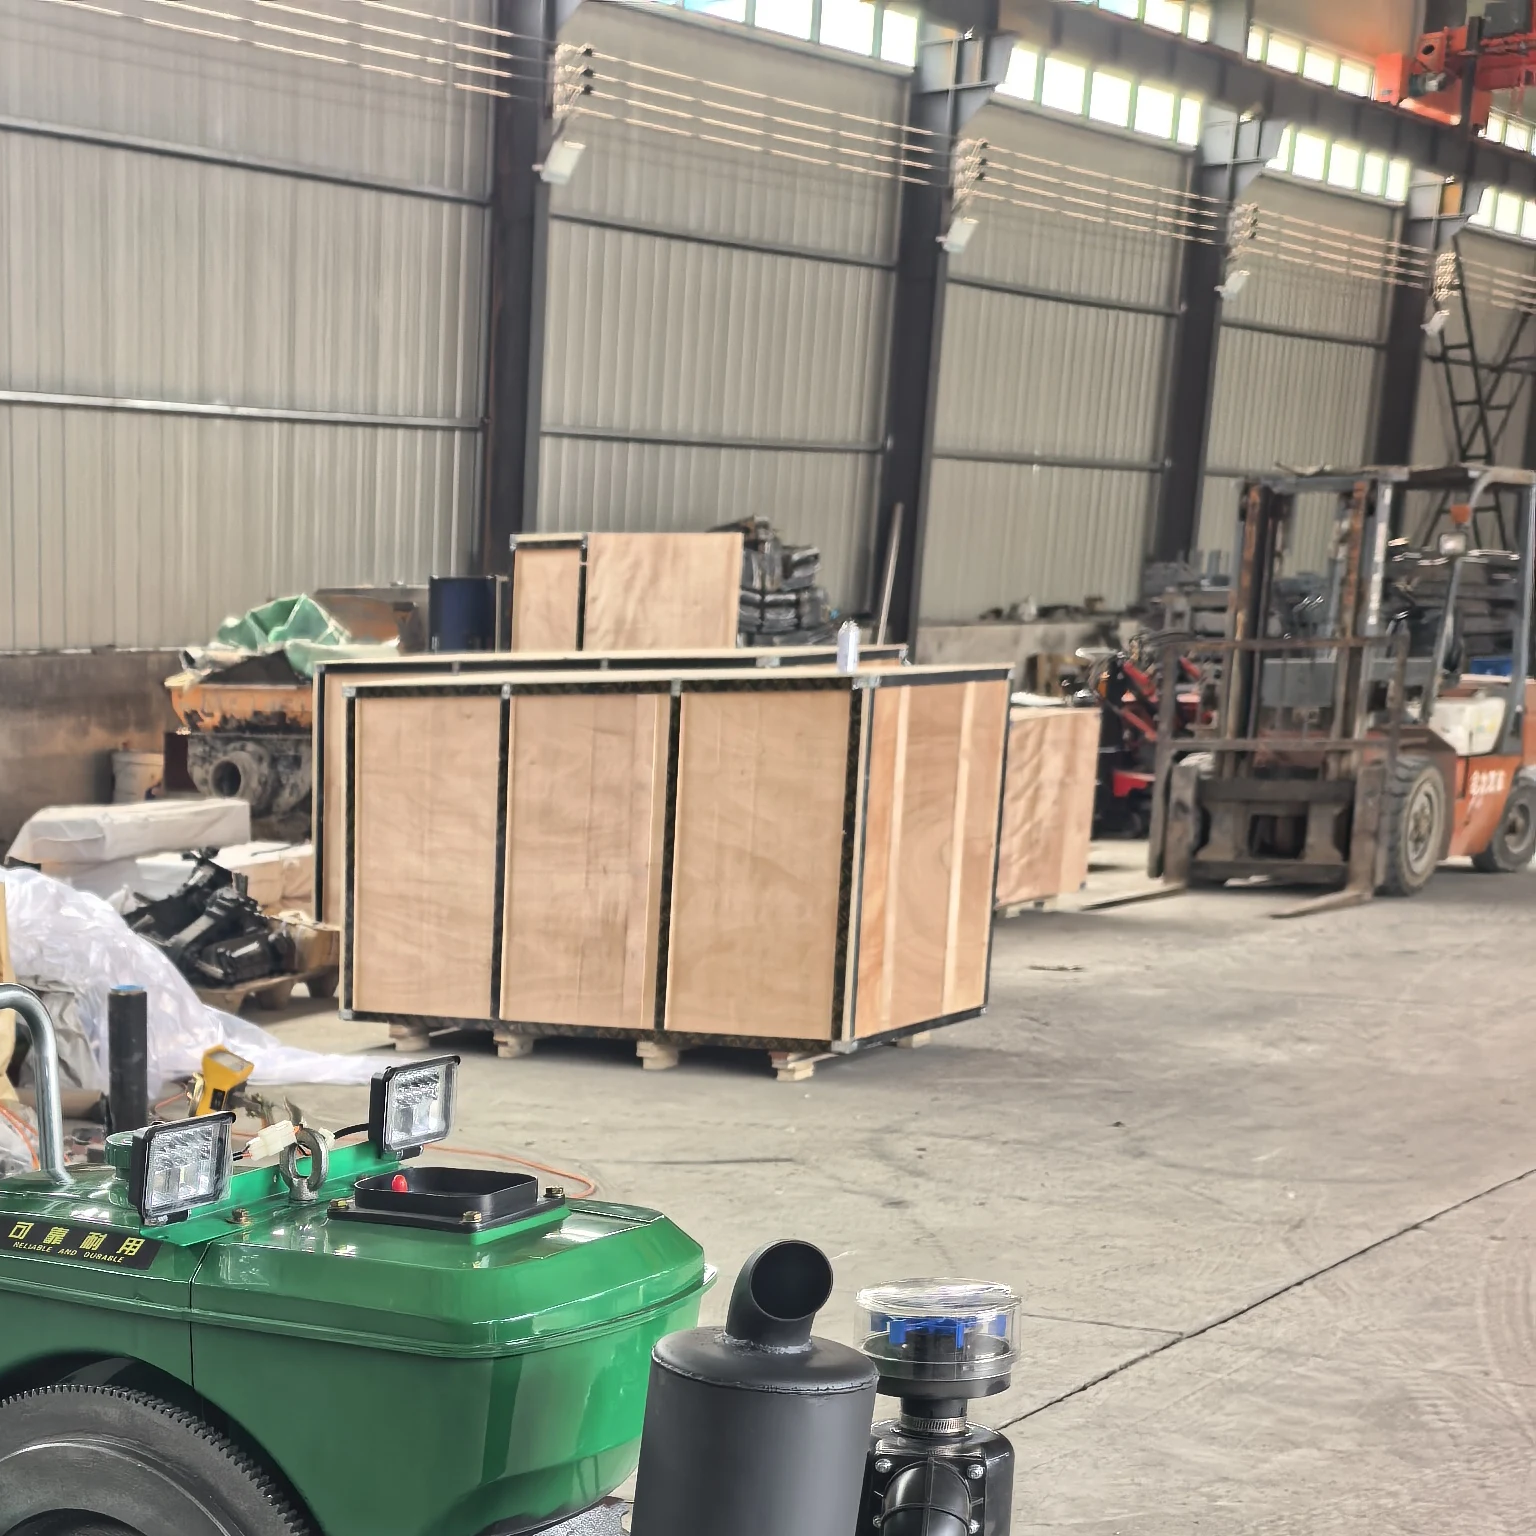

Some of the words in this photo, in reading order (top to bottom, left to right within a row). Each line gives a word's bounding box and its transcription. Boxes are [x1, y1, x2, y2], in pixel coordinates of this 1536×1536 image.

[8, 1221, 145, 1256] 可靠耐用
[13, 1241, 53, 1253] RELIABLE
[58, 1248, 78, 1256] AND
[84, 1251, 125, 1264] DURABLE
